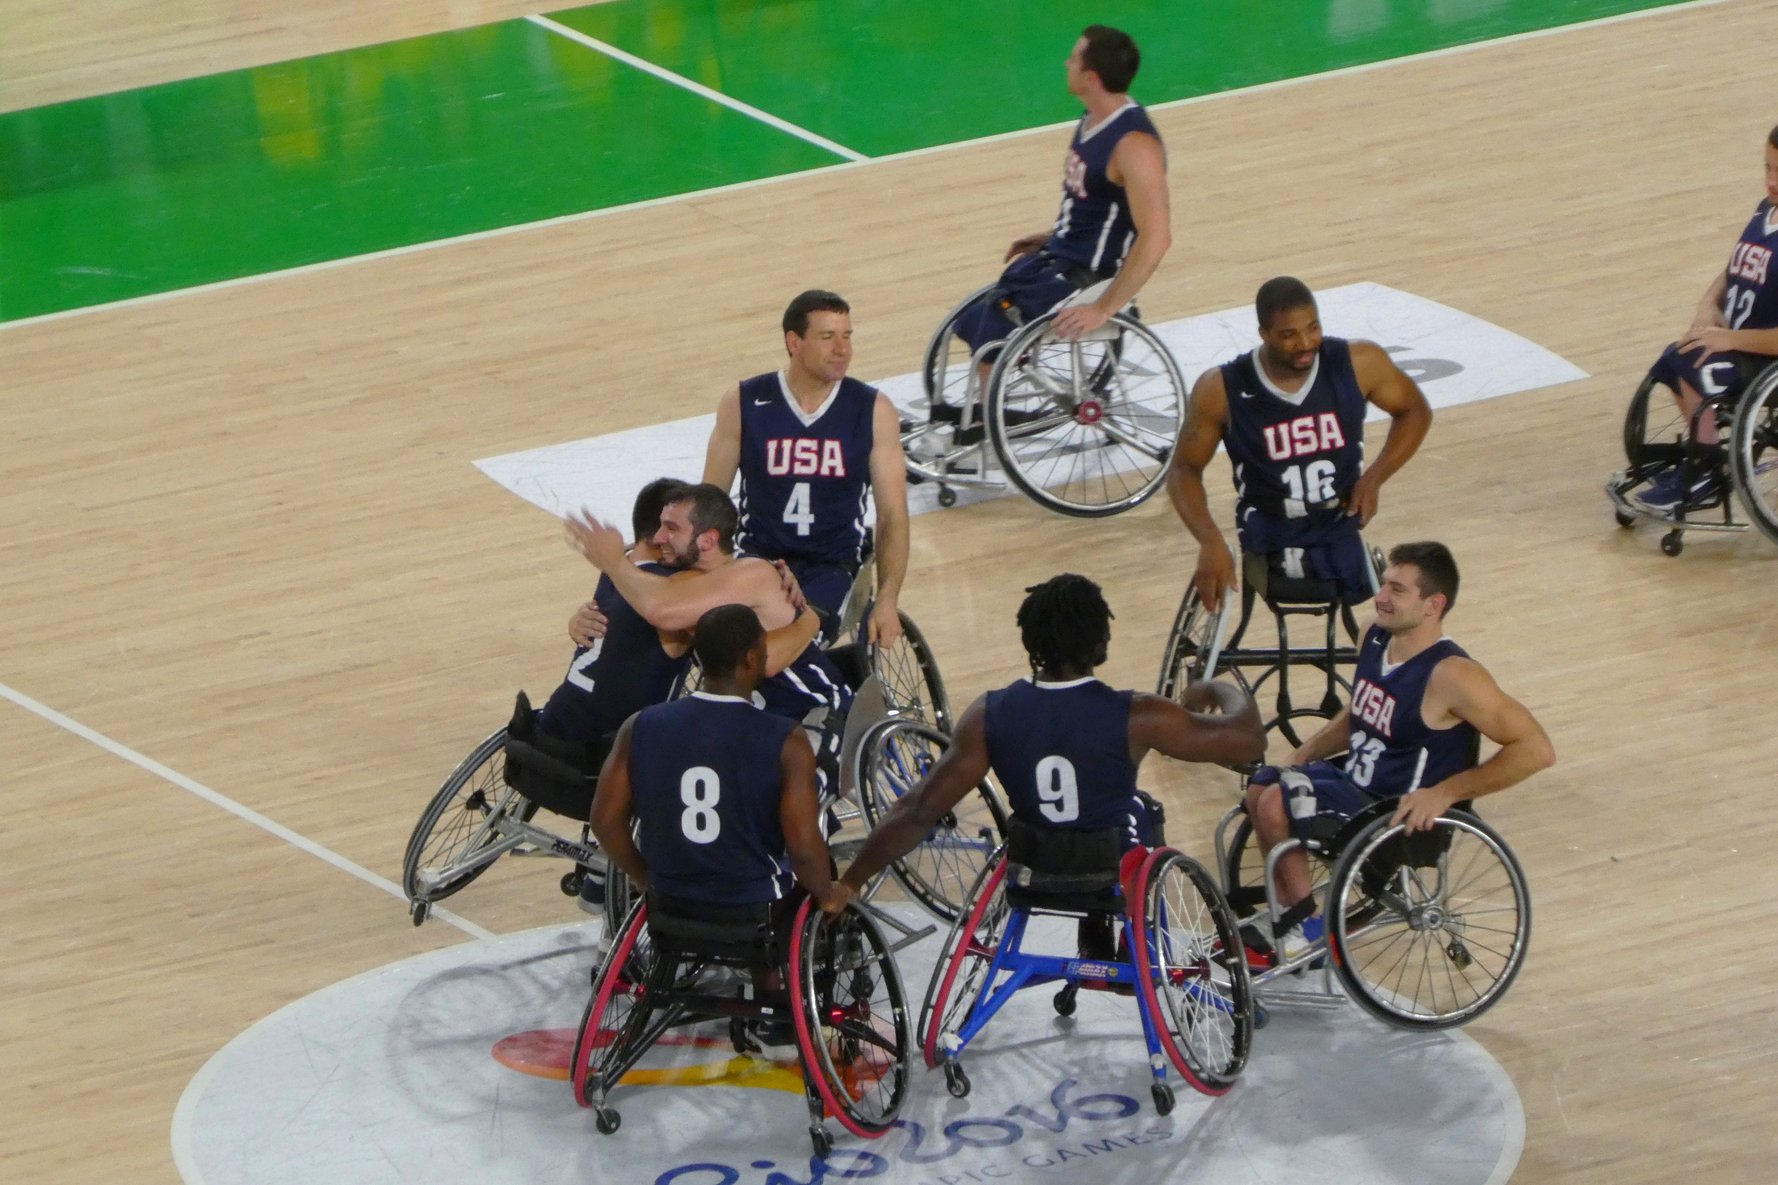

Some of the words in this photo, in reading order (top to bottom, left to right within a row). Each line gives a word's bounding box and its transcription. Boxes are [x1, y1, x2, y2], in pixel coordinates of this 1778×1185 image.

[1728, 241, 1773, 285] USA
[1724, 284, 1756, 331] 12
[766, 438, 847, 478] USA
[1264, 411, 1346, 461] USA
[782, 482, 815, 536] 4
[1281, 459, 1337, 519] 16
[1351, 679, 1397, 739] USA
[680, 765, 721, 844] 8
[1035, 755, 1080, 823] 9
[1022, 1126, 1173, 1168] GAMES
